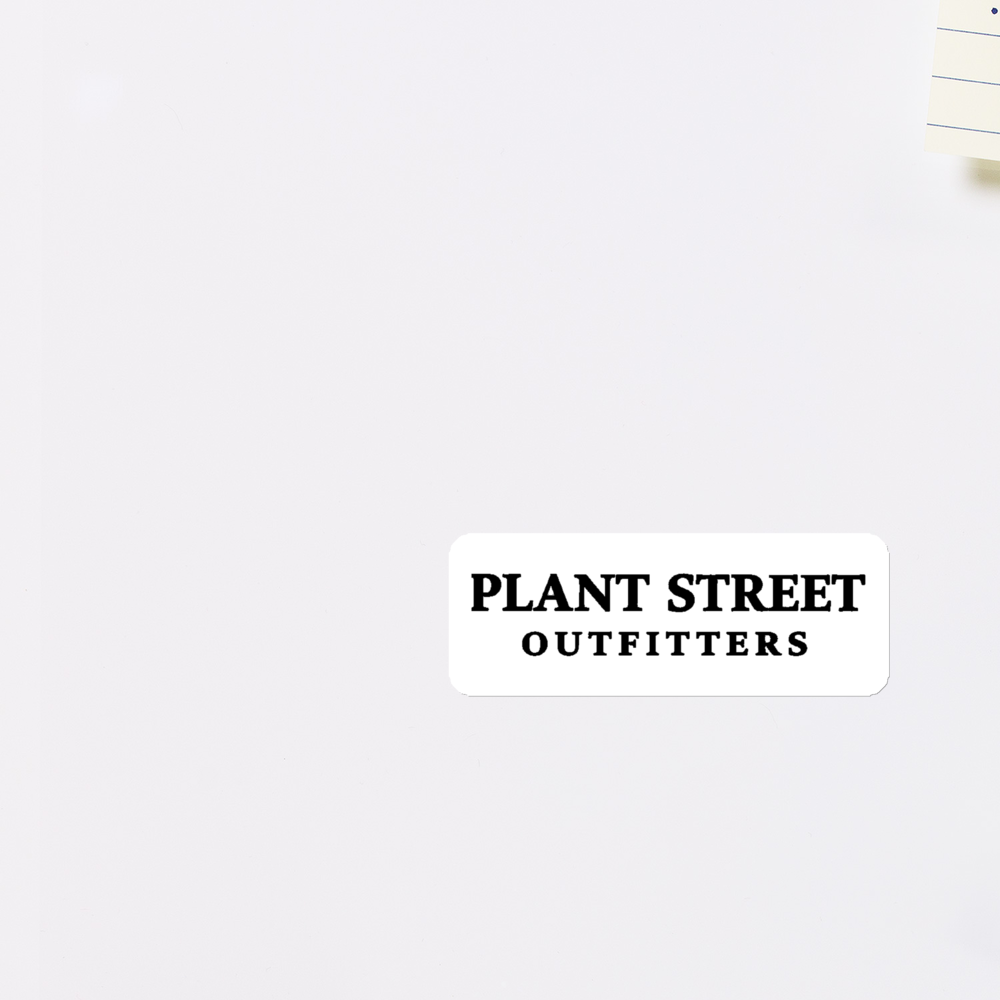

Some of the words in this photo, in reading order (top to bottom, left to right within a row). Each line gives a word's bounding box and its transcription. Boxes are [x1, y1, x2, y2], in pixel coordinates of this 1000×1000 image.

[471, 573, 650, 612] PLANT
[668, 573, 866, 612] STREET
[522, 631, 808, 656] OUTFITTERS
